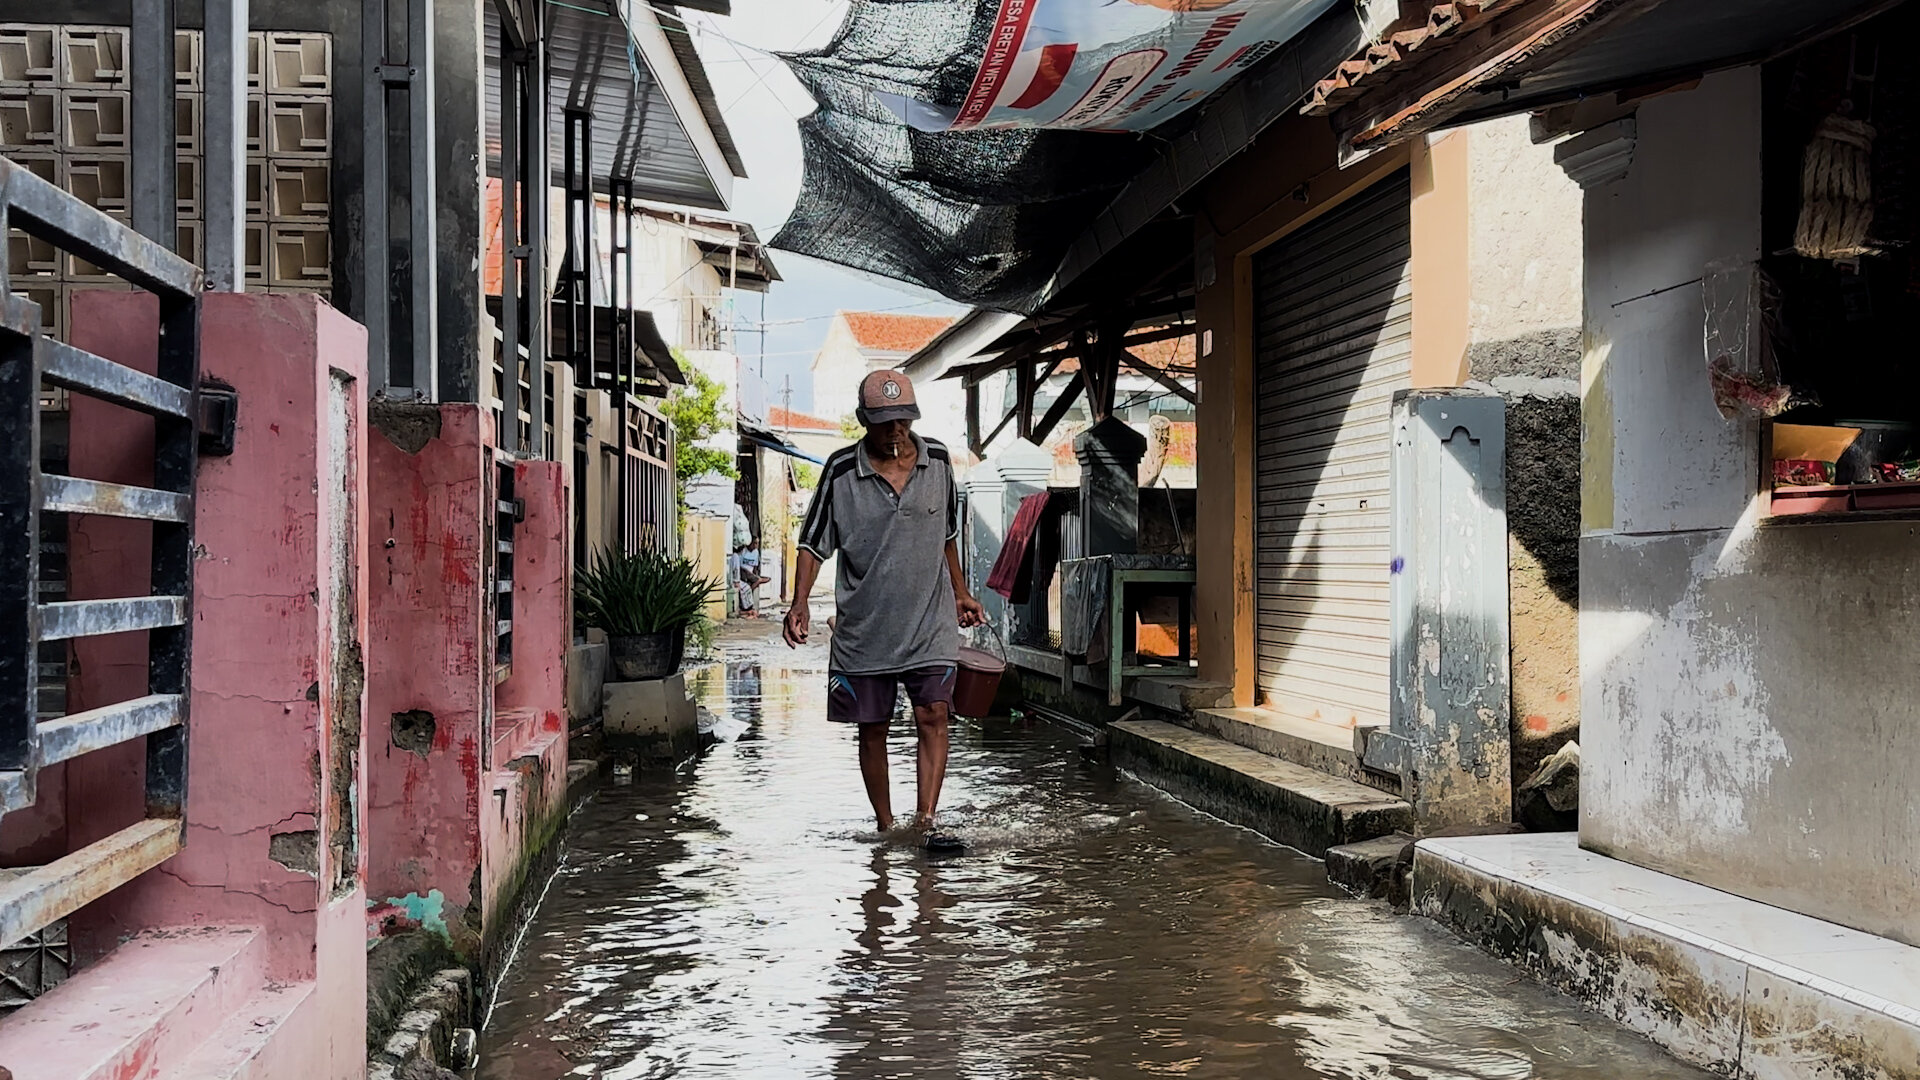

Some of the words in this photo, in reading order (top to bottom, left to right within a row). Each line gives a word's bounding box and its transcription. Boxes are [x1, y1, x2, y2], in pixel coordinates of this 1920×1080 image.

[988, 25, 1017, 66] ERETAN
[1162, 11, 1248, 80] WARUNG
[974, 67, 1001, 98] WETAN
